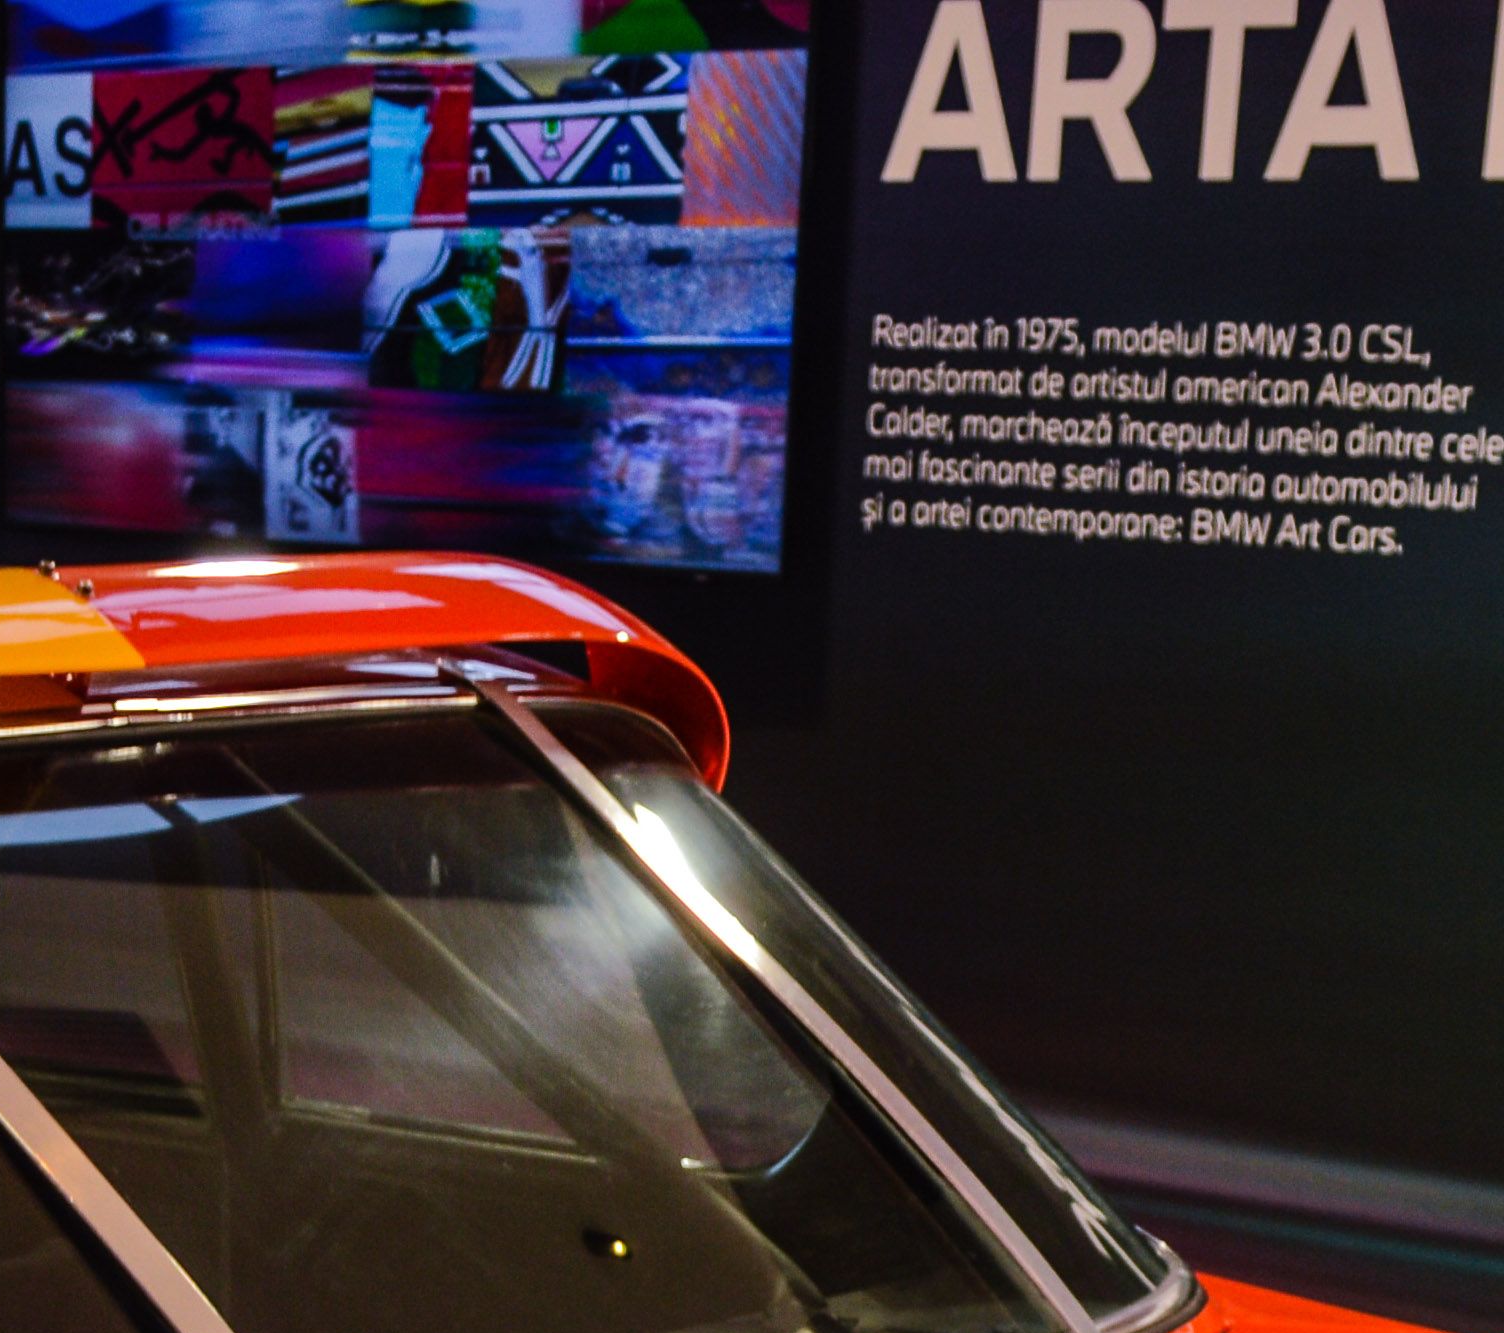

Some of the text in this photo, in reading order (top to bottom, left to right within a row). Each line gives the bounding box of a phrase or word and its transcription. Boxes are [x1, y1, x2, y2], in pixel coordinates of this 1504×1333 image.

[872, 314, 1432, 369] Realizat în 1975, modelul BMW 3.0 CSL,
[868, 361, 1473, 414] transformat de artistul american Alexander
[866, 402, 954, 444] Calder,
[960, 410, 1113, 446] marchează
[1118, 413, 1250, 453] începutul
[1255, 421, 1338, 456] uneia
[1345, 422, 1435, 460] dintre
[863, 450, 1478, 511] mai fascinante serii din istoria automobilului
[861, 492, 1404, 556] și a artei contemporane: BMW Art Cars.
